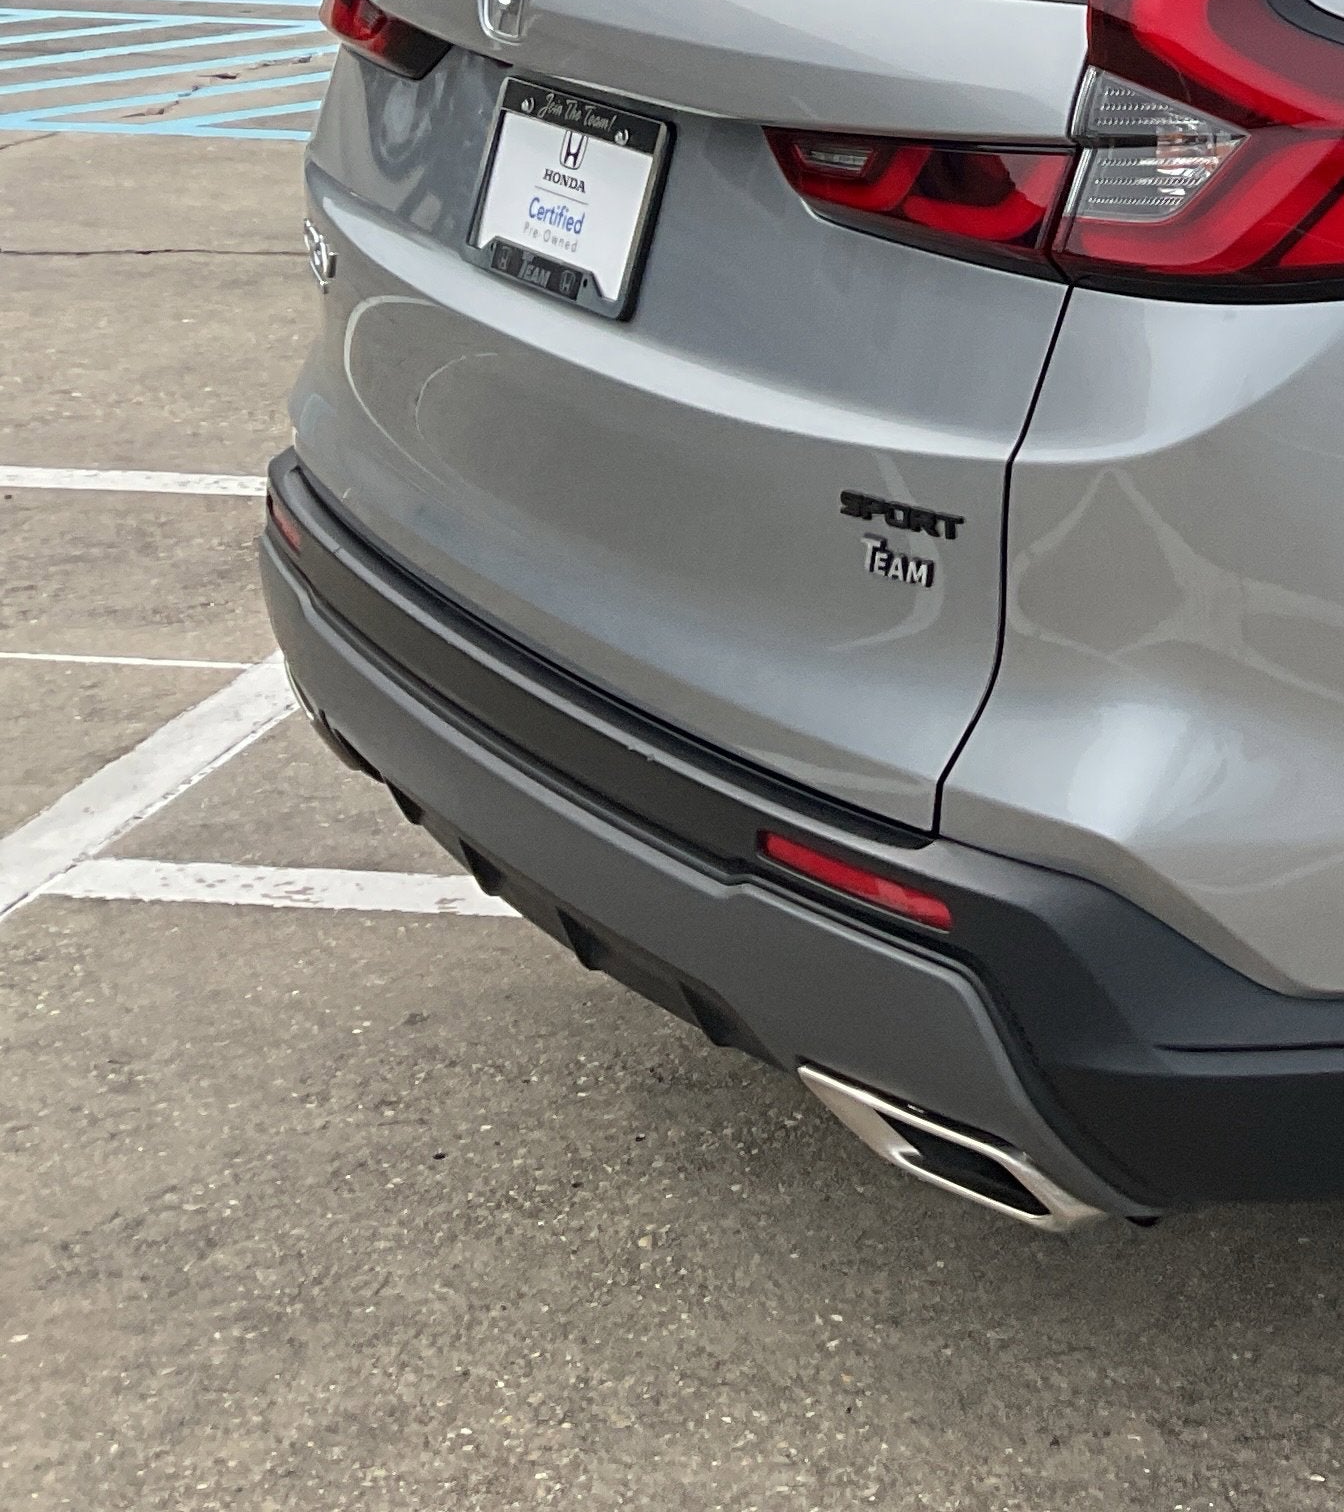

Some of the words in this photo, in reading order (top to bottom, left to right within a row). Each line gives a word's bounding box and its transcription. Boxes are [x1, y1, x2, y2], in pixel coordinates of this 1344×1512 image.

[537, 93, 563, 118] Join
[564, 99, 582, 121] The
[543, 168, 586, 194] HONDA
[528, 196, 585, 235] Certified
[517, 250, 551, 288] TEAM
[840, 489, 965, 539] SPORT
[861, 533, 935, 588] TEAM
